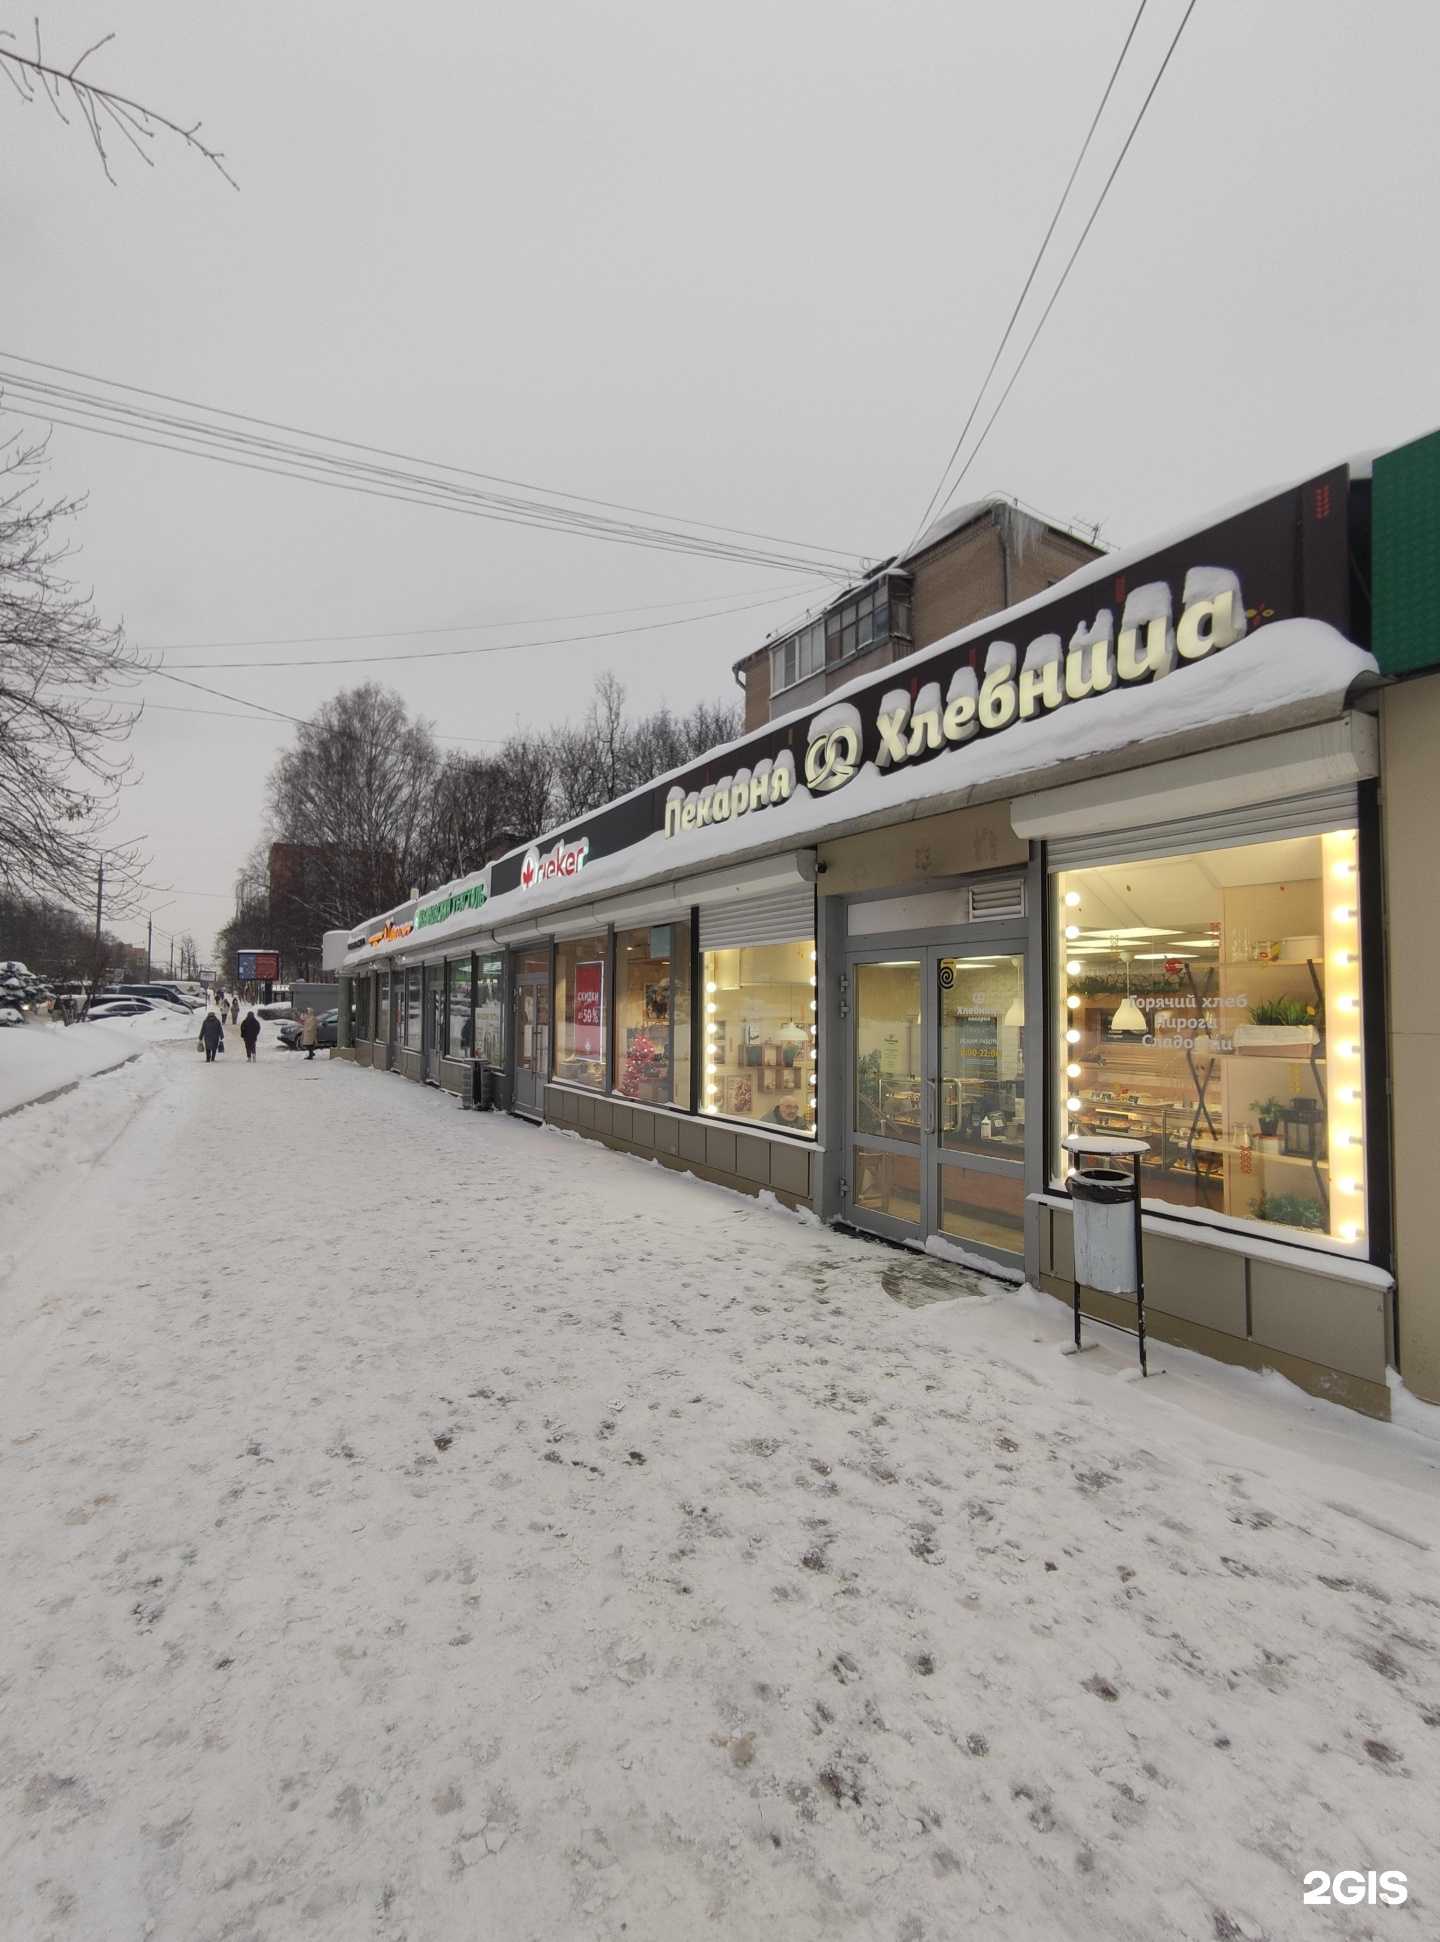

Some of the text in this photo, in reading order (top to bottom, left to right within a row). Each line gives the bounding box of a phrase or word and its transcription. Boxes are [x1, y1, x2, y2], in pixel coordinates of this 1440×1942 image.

[664, 574, 1246, 840] Пекарня Хлебница
[537, 845, 588, 882] rieker
[577, 991, 599, 1003] СКИДКИ
[1130, 993, 1248, 1012] Горячий хлеб
[1141, 1034, 1232, 1051] Сладои
